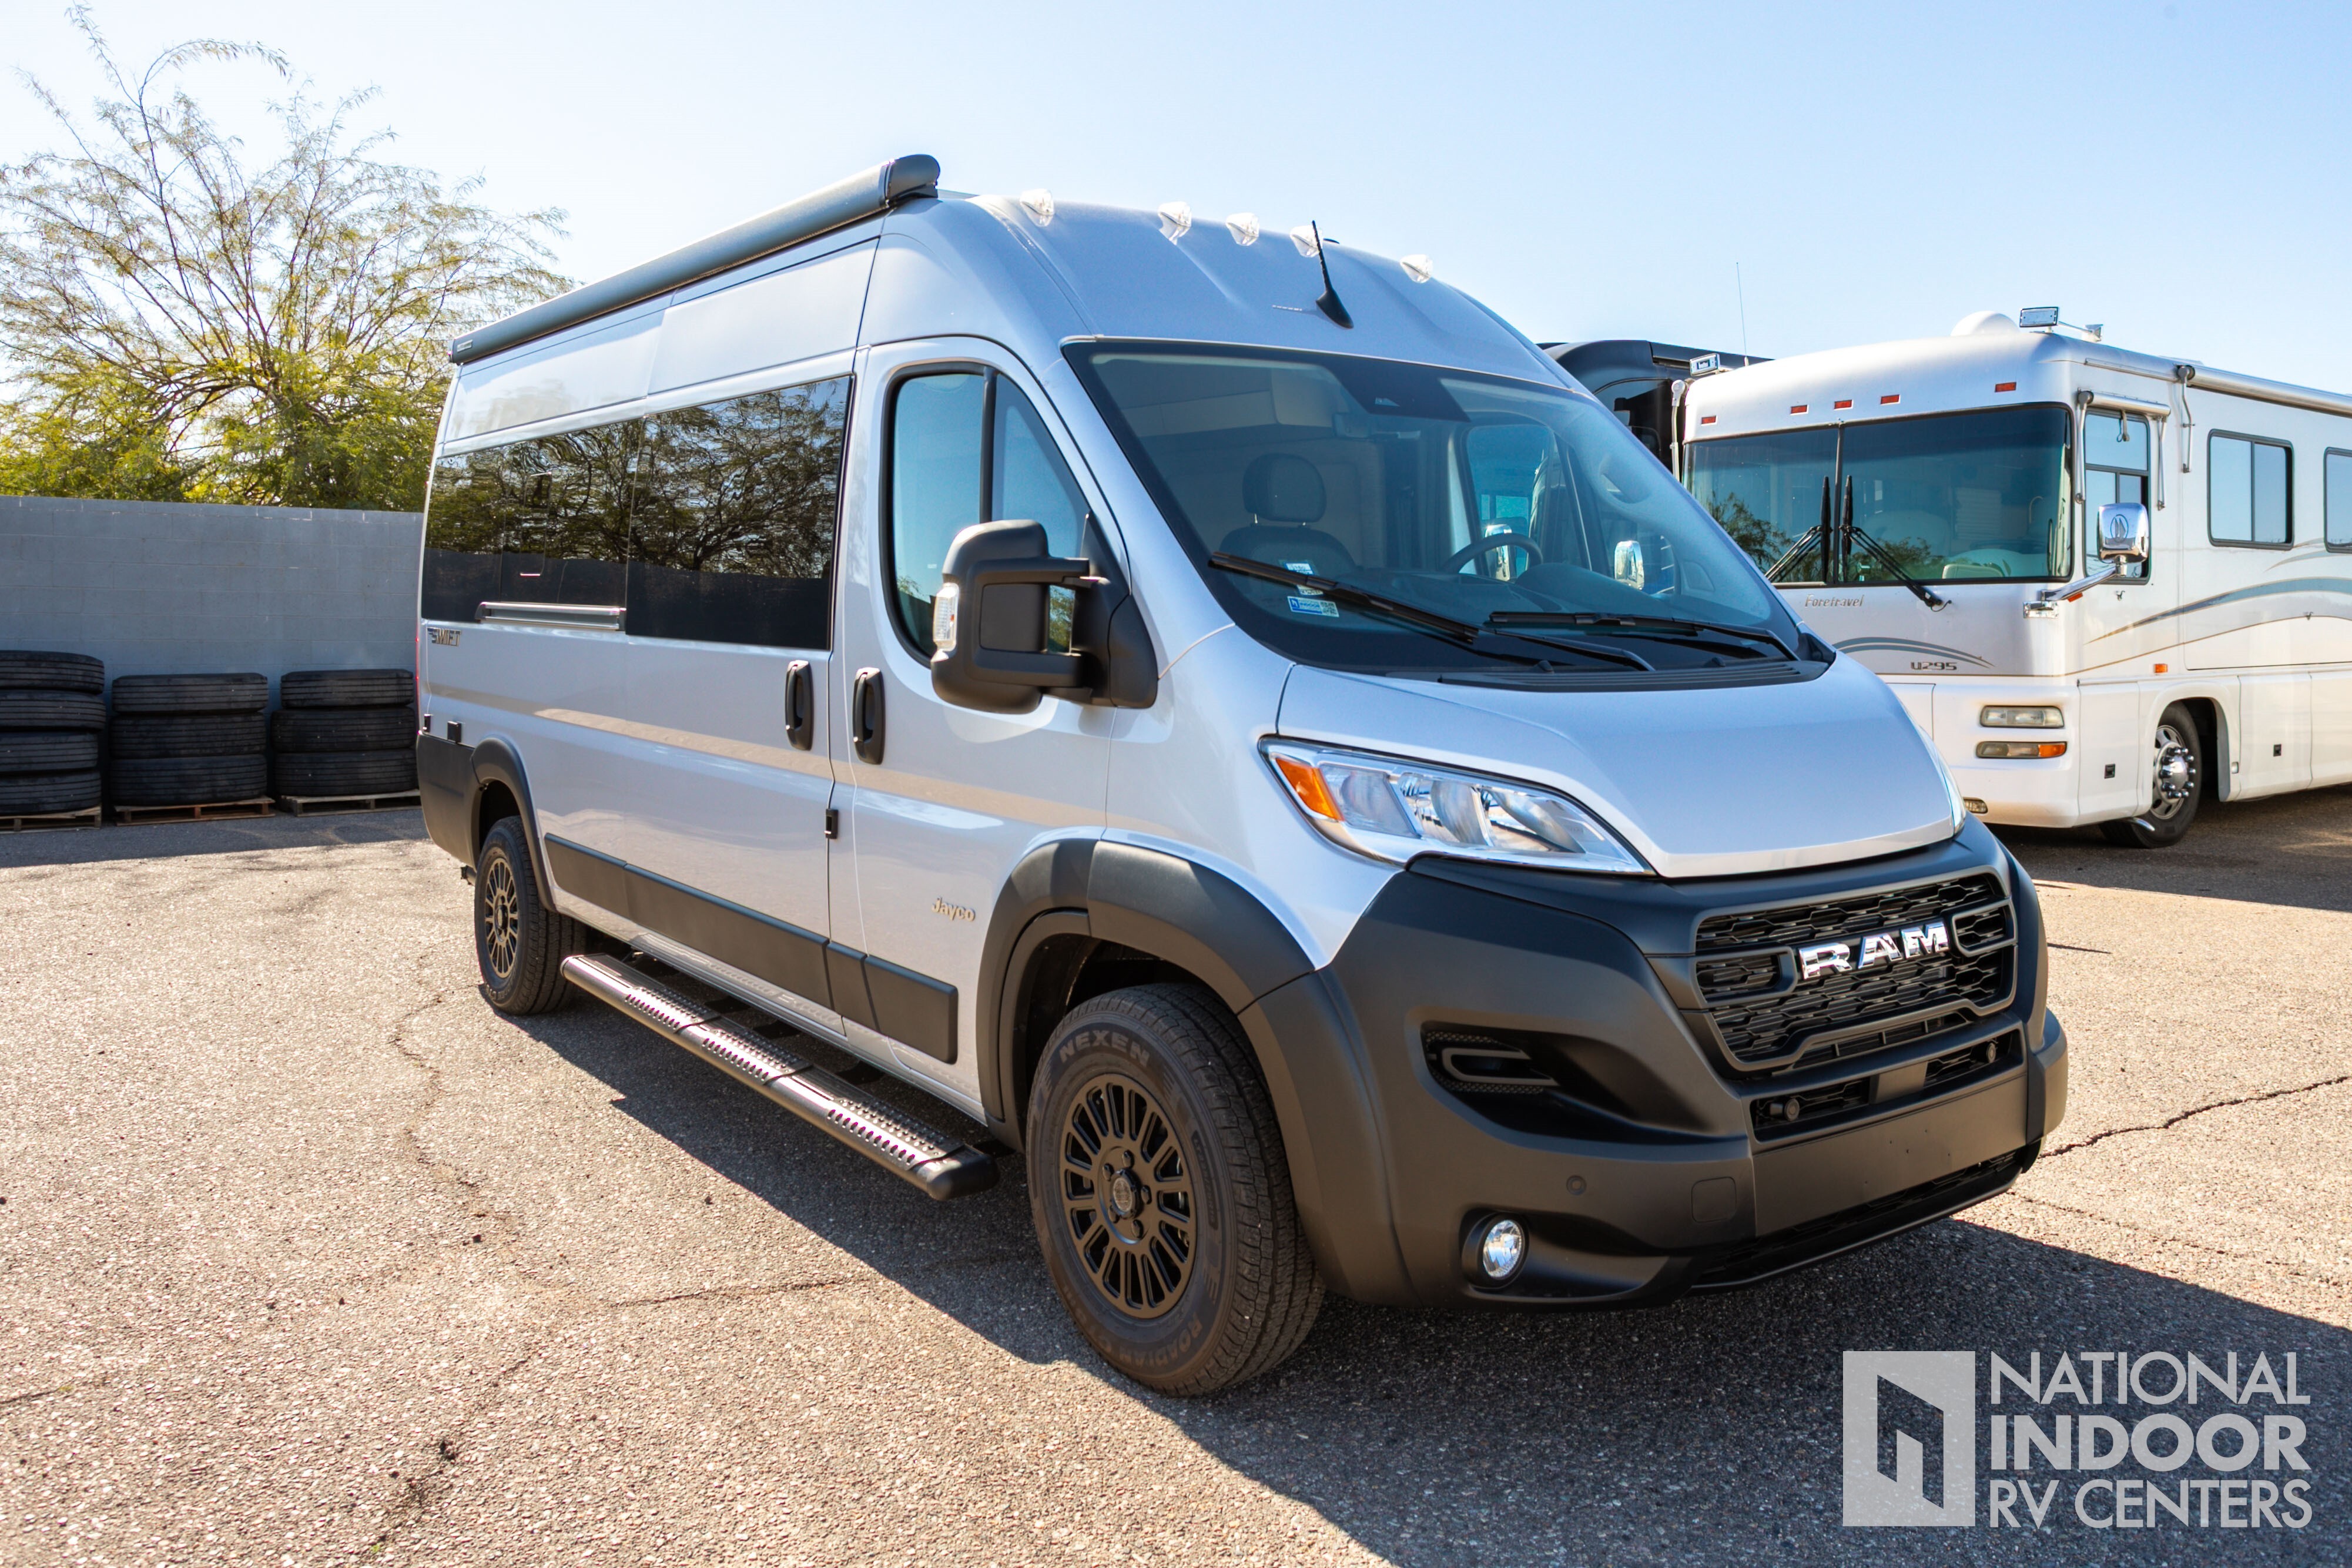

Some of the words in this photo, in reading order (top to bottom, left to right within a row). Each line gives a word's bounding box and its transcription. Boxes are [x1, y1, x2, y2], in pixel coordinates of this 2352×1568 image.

[1805, 594, 1864, 608] Foretravel
[427, 627, 461, 647] SWIFT
[1911, 661, 1958, 671] U295
[1798, 921, 1949, 980] RAM
[1059, 1030, 1150, 1067] NEXEN
